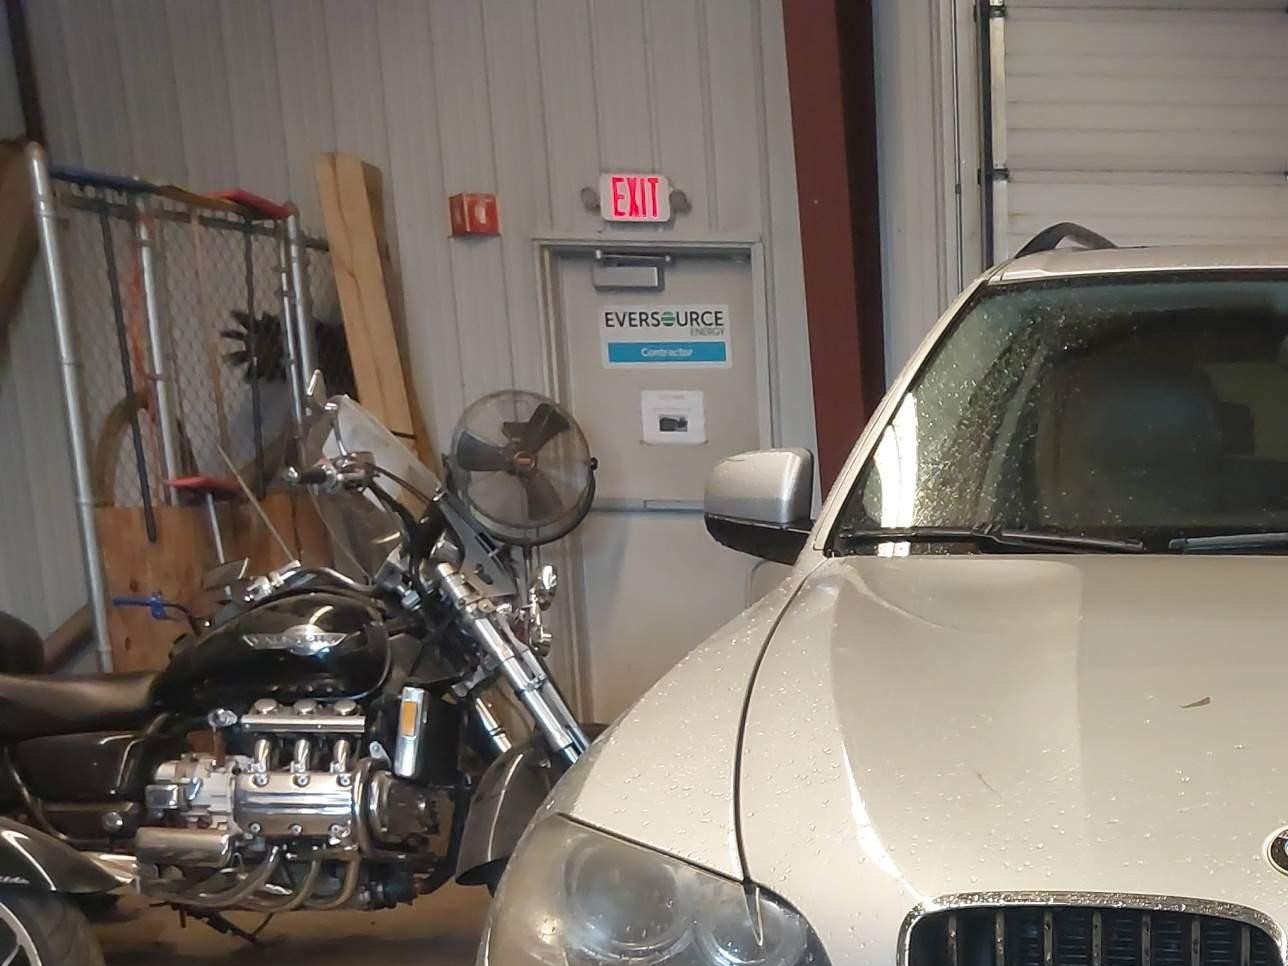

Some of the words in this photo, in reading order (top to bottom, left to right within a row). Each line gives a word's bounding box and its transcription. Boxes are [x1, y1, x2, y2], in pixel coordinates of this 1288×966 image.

[610, 176, 660, 218] EXIT
[604, 310, 725, 328] EVERSOURCE
[690, 327, 726, 337] ENERGY
[640, 346, 694, 358] Contractor
